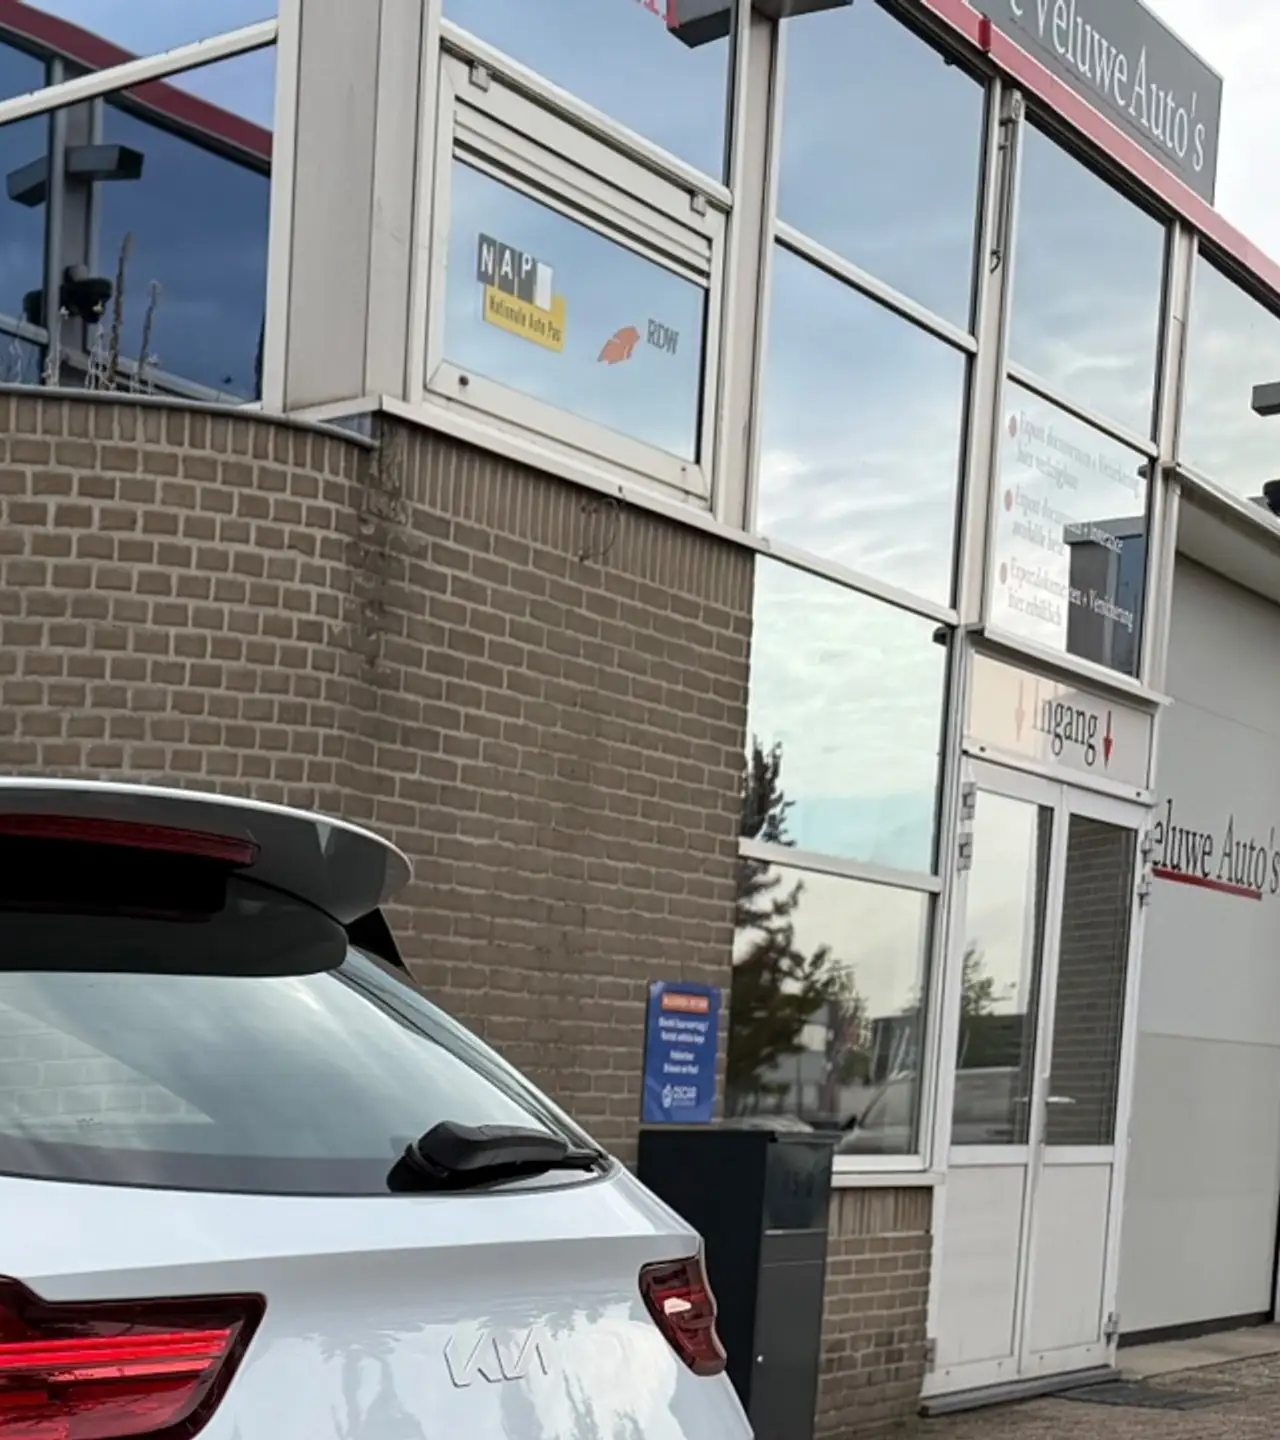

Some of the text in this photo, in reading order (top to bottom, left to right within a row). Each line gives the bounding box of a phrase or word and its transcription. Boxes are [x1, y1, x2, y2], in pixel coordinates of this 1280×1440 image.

[1128, 45, 1206, 172] Auto's
[480, 242, 533, 280] NAP
[647, 317, 679, 355] RDW
[1152, 798, 1280, 895] eluwe Auto's
